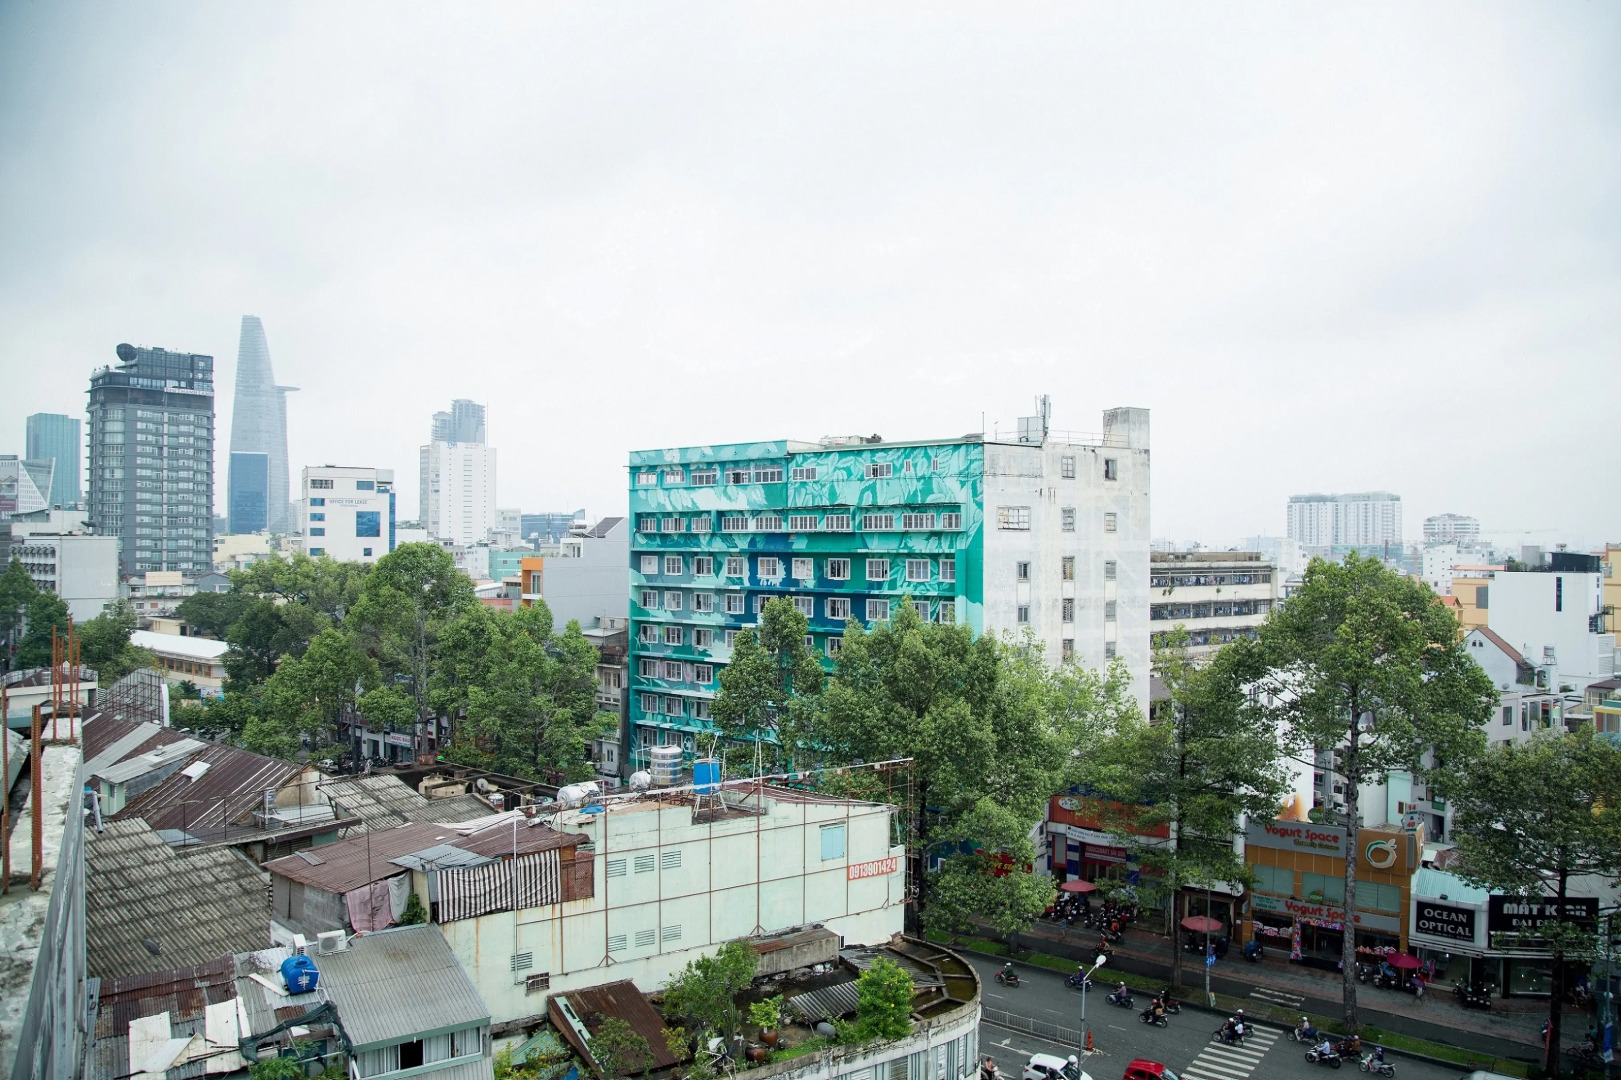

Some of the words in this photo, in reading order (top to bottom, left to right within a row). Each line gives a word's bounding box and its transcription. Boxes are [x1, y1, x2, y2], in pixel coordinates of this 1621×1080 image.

[1264, 823, 1302, 838] Yogurt
[1304, 829, 1340, 843] Space
[1284, 900, 1323, 917] Yogurt
[1325, 907, 1361, 924] Spae
[1423, 908, 1467, 923] OCEAN
[1418, 920, 1472, 936] OPTICAL
